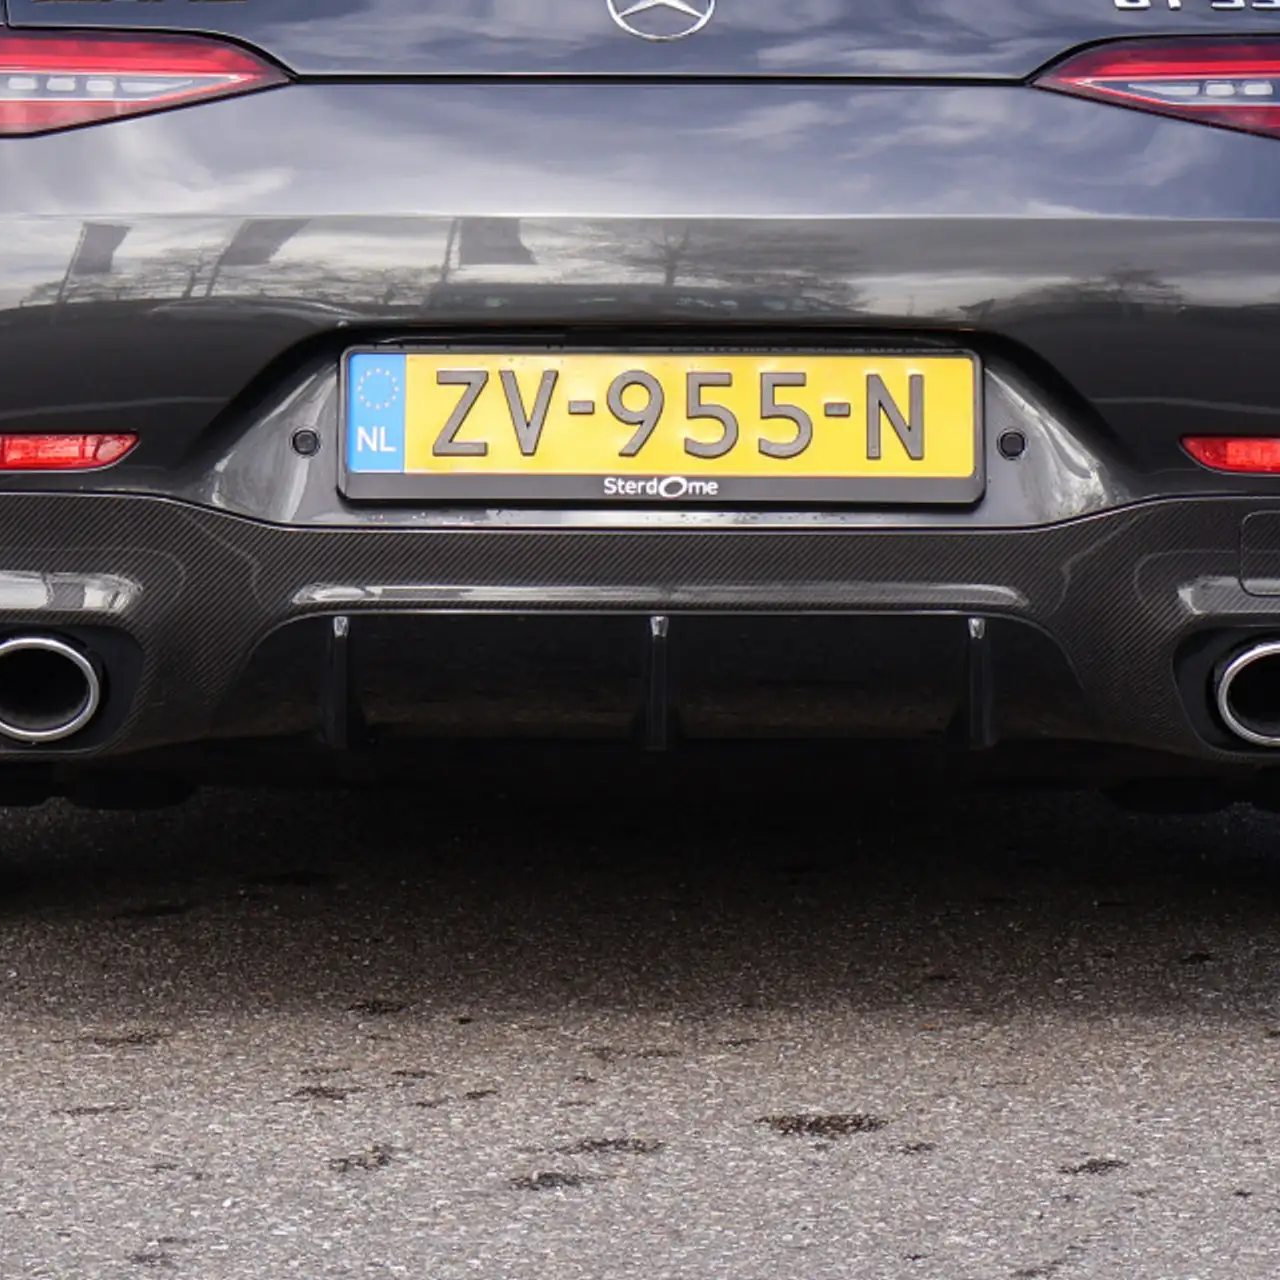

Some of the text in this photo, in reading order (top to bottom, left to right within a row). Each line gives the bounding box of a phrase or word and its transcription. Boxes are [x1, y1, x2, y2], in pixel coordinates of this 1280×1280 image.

[356, 369, 925, 460] NL ZV-955-N
[603, 475, 719, 499] SterdOme
